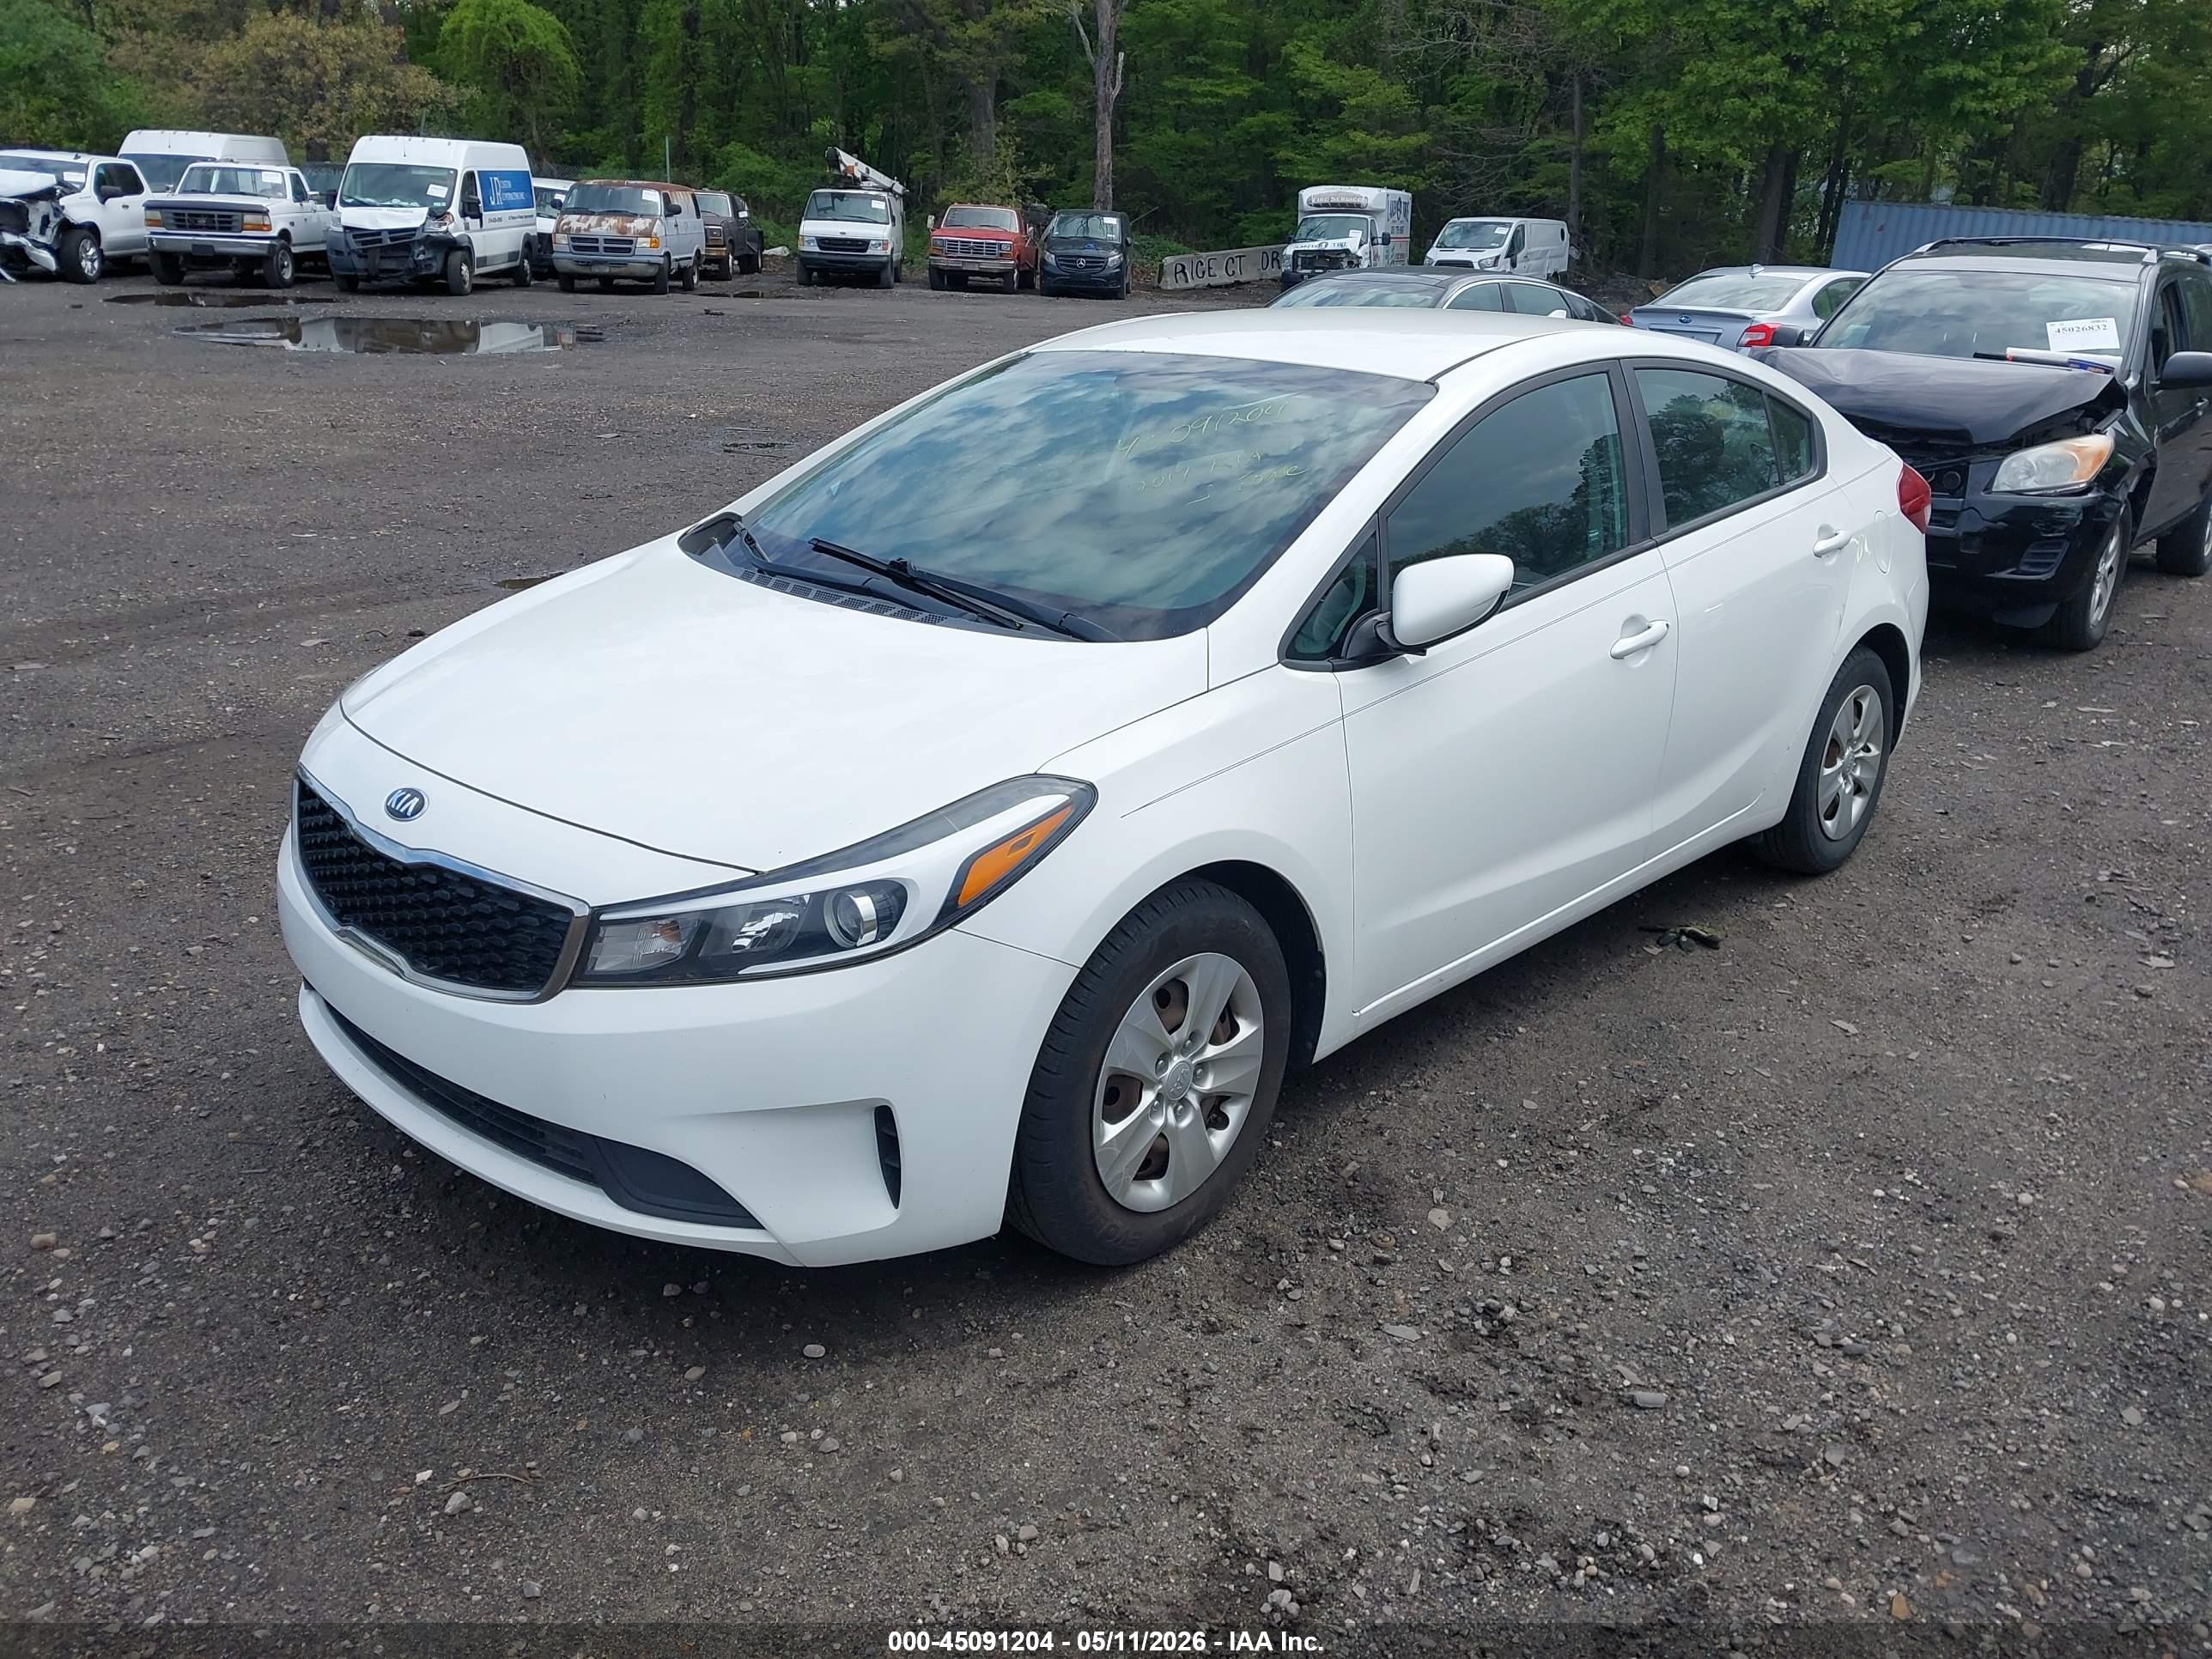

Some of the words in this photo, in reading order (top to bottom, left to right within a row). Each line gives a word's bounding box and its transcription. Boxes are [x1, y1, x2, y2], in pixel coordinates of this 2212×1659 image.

[1174, 258, 1218, 283] RICE
[1224, 254, 1247, 277] CT
[1261, 250, 1281, 270] DR
[2054, 324, 2108, 334] 45026832
